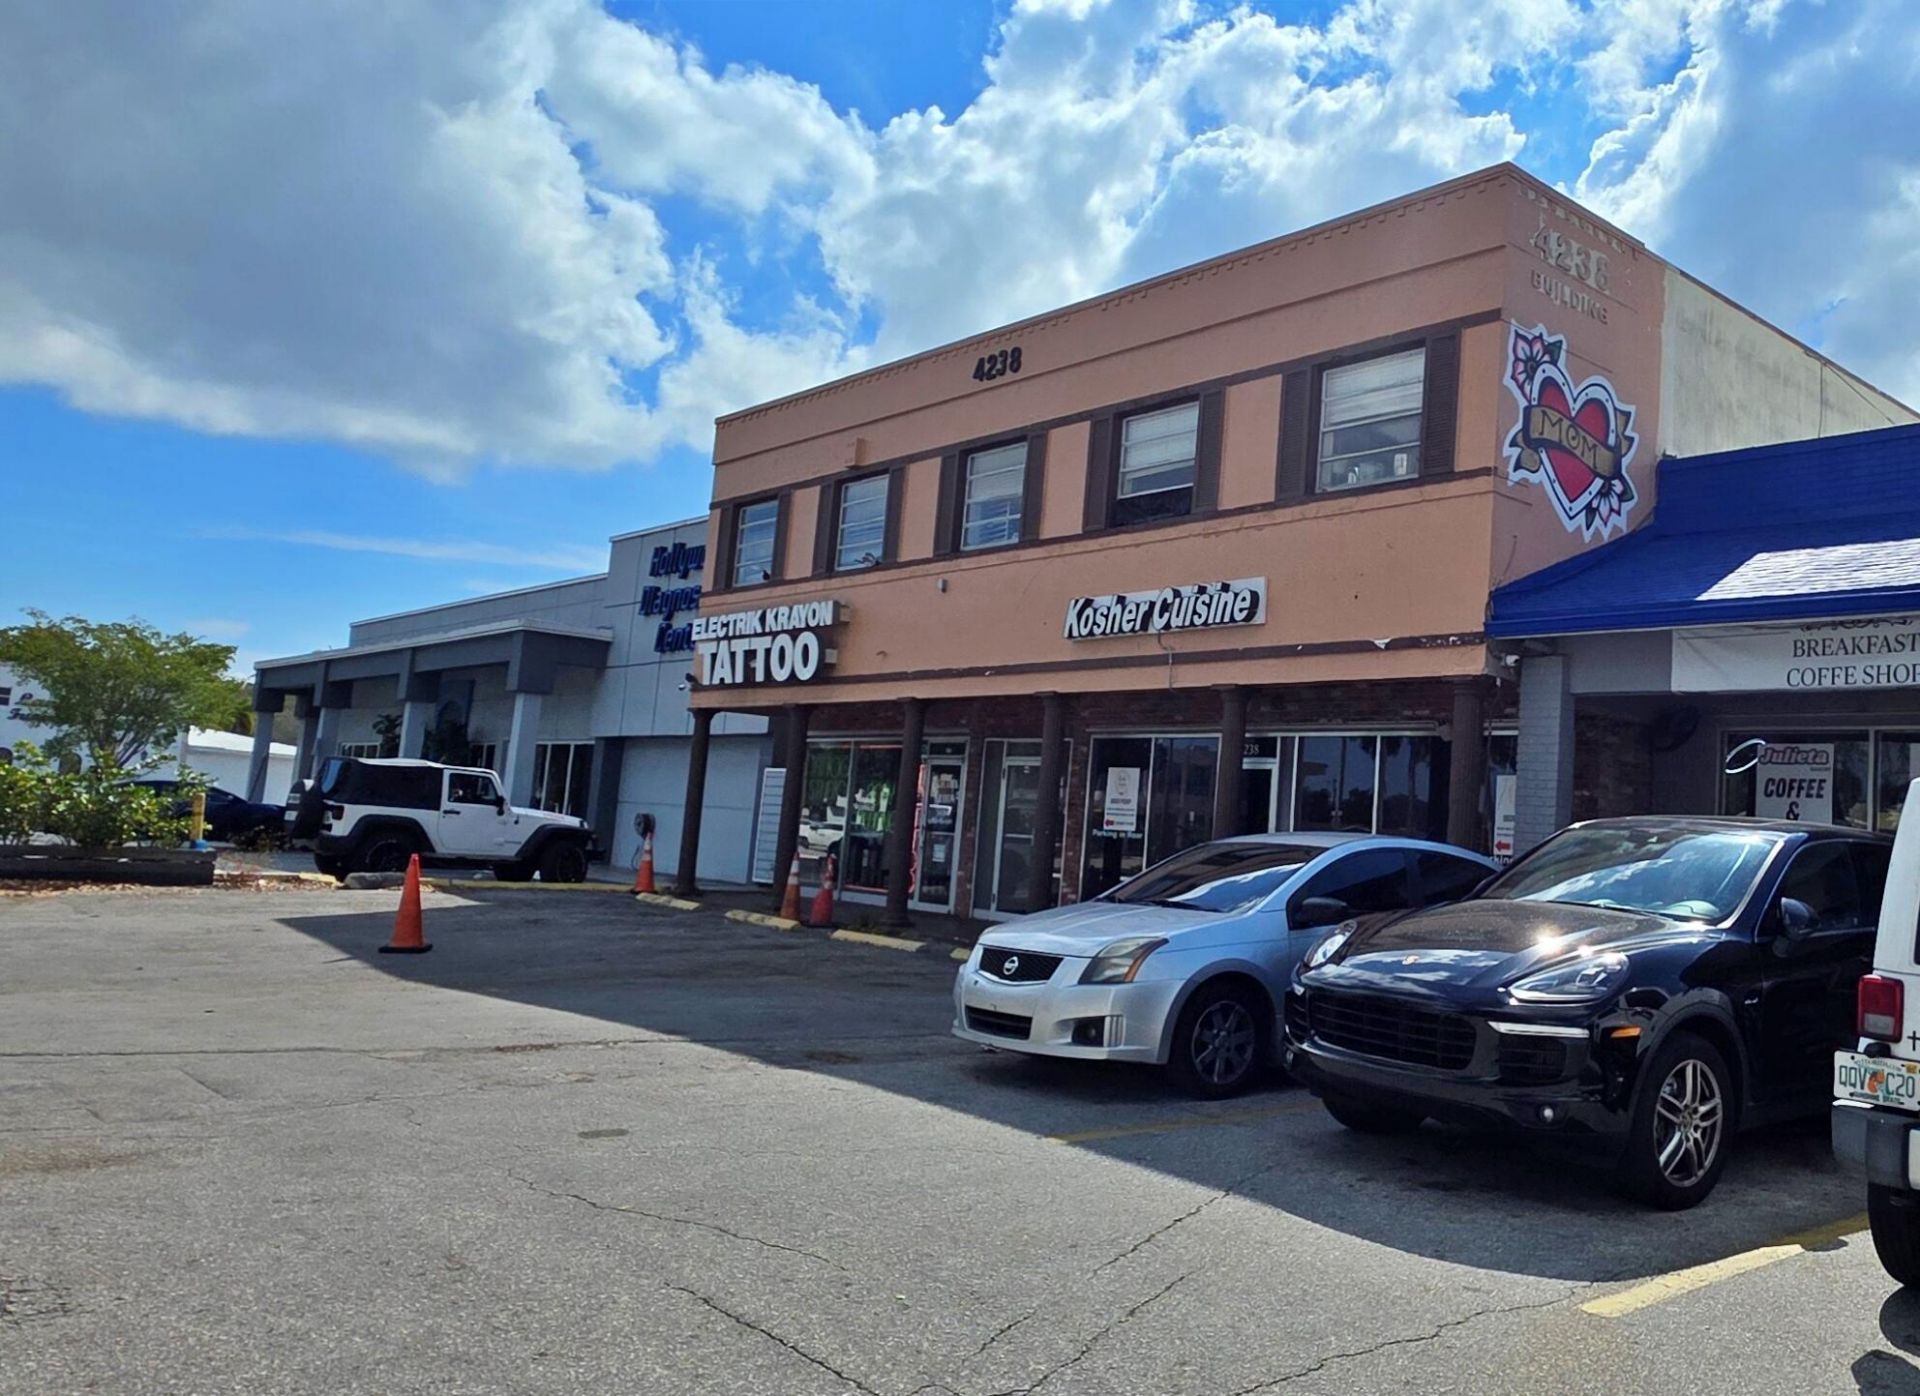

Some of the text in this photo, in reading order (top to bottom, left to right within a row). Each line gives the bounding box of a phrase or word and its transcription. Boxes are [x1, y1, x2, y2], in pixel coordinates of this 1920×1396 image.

[972, 346, 1022, 382] 4238
[691, 600, 833, 641] ELECTRIK KRAYON
[1064, 582, 1260, 638] Kosher Cuisine
[1792, 632, 1920, 658] BREAKFAST
[698, 631, 819, 686] TATTOO
[1786, 665, 1857, 688] COFFE
[1759, 745, 1829, 766] Julieta
[1764, 777, 1827, 799] COFFEE
[1885, 1072, 1915, 1098] C20
